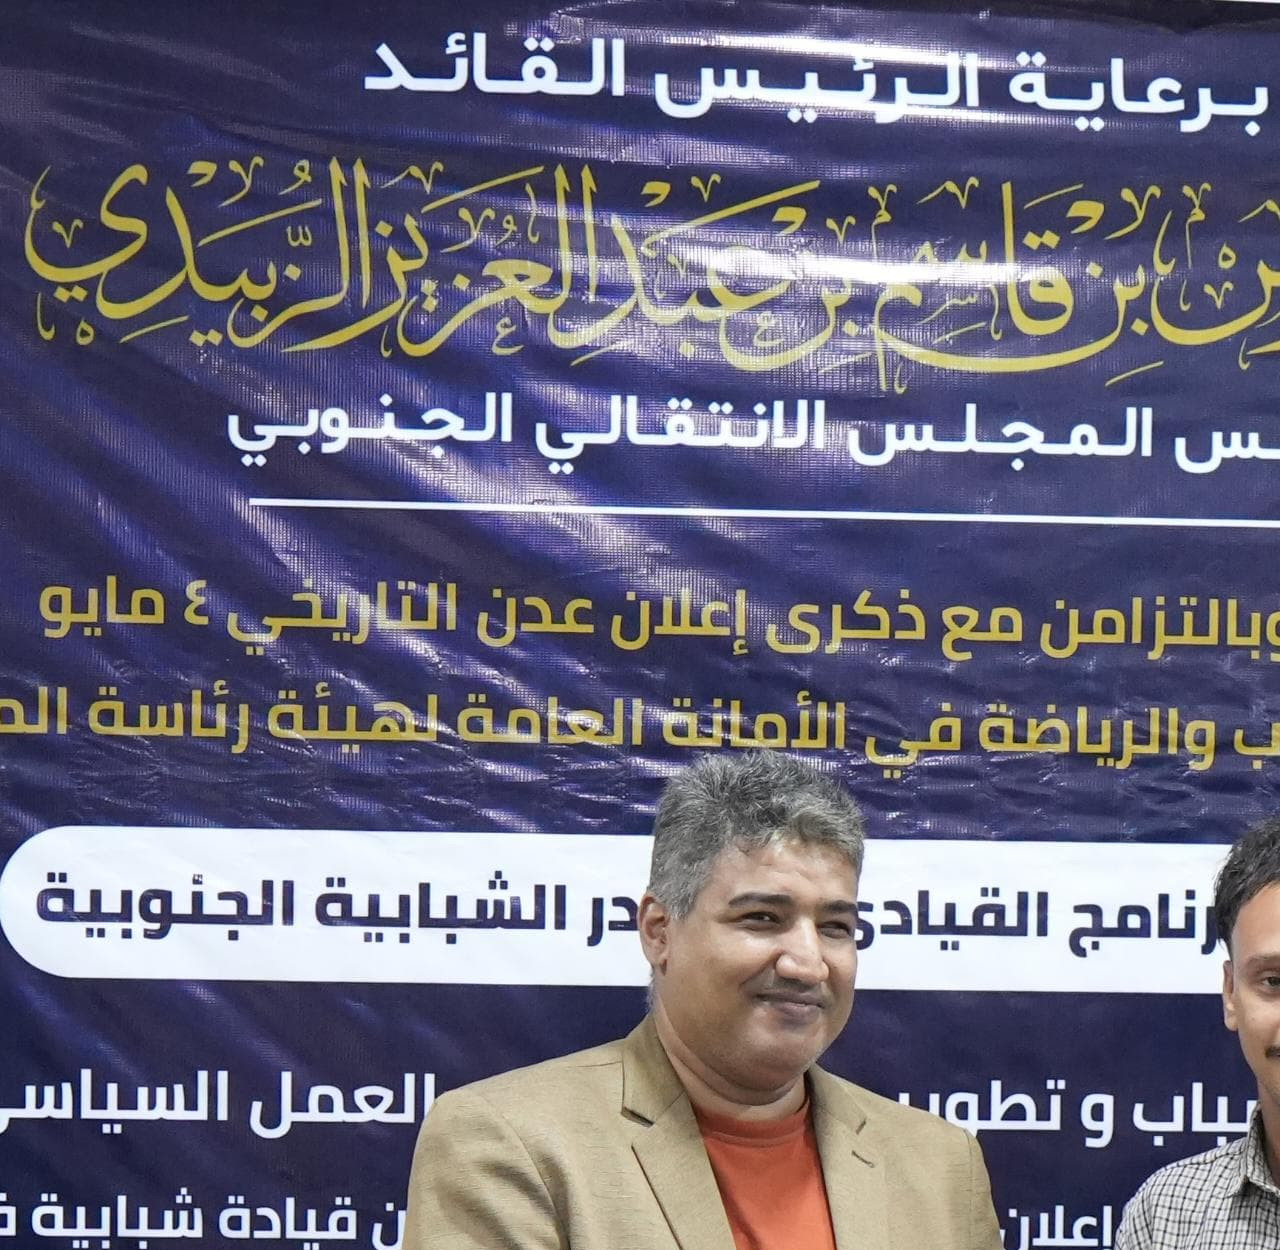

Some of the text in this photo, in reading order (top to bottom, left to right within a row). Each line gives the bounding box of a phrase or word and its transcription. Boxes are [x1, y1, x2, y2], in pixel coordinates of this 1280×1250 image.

[364, 31, 1269, 136] برعاية الرئيس القائد
[227, 391, 512, 467] الجنوبي
[536, 393, 825, 473] الانتقالي
[847, 401, 1153, 469] المجلس
[40, 574, 166, 638] مايو
[182, 579, 209, 627] ٤
[226, 580, 457, 657] التاريخي
[477, 585, 594, 648] عدن
[610, 588, 747, 656] إعلان
[765, 588, 926, 655] ذكرى
[941, 602, 1022, 662] مع
[0, 685, 68, 735] الم
[87, 678, 249, 754] رئاسة
[267, 680, 438, 754] لهيئة
[458, 694, 644, 748] العامة
[662, 690, 845, 751] الأمانة
[864, 702, 962, 780] في
[978, 701, 1217, 771] والرياضة
[36, 871, 294, 940] الجنوبية
[314, 870, 567, 944] الشبابية
[1068, 888, 1218, 958] رنامج
[0, 1068, 229, 1134] السياس
[249, 1070, 436, 1139] العمل
[1080, 1092, 1115, 1148] و
[31, 1187, 203, 1250] شبابية
[218, 1195, 357, 1250] قيادة
